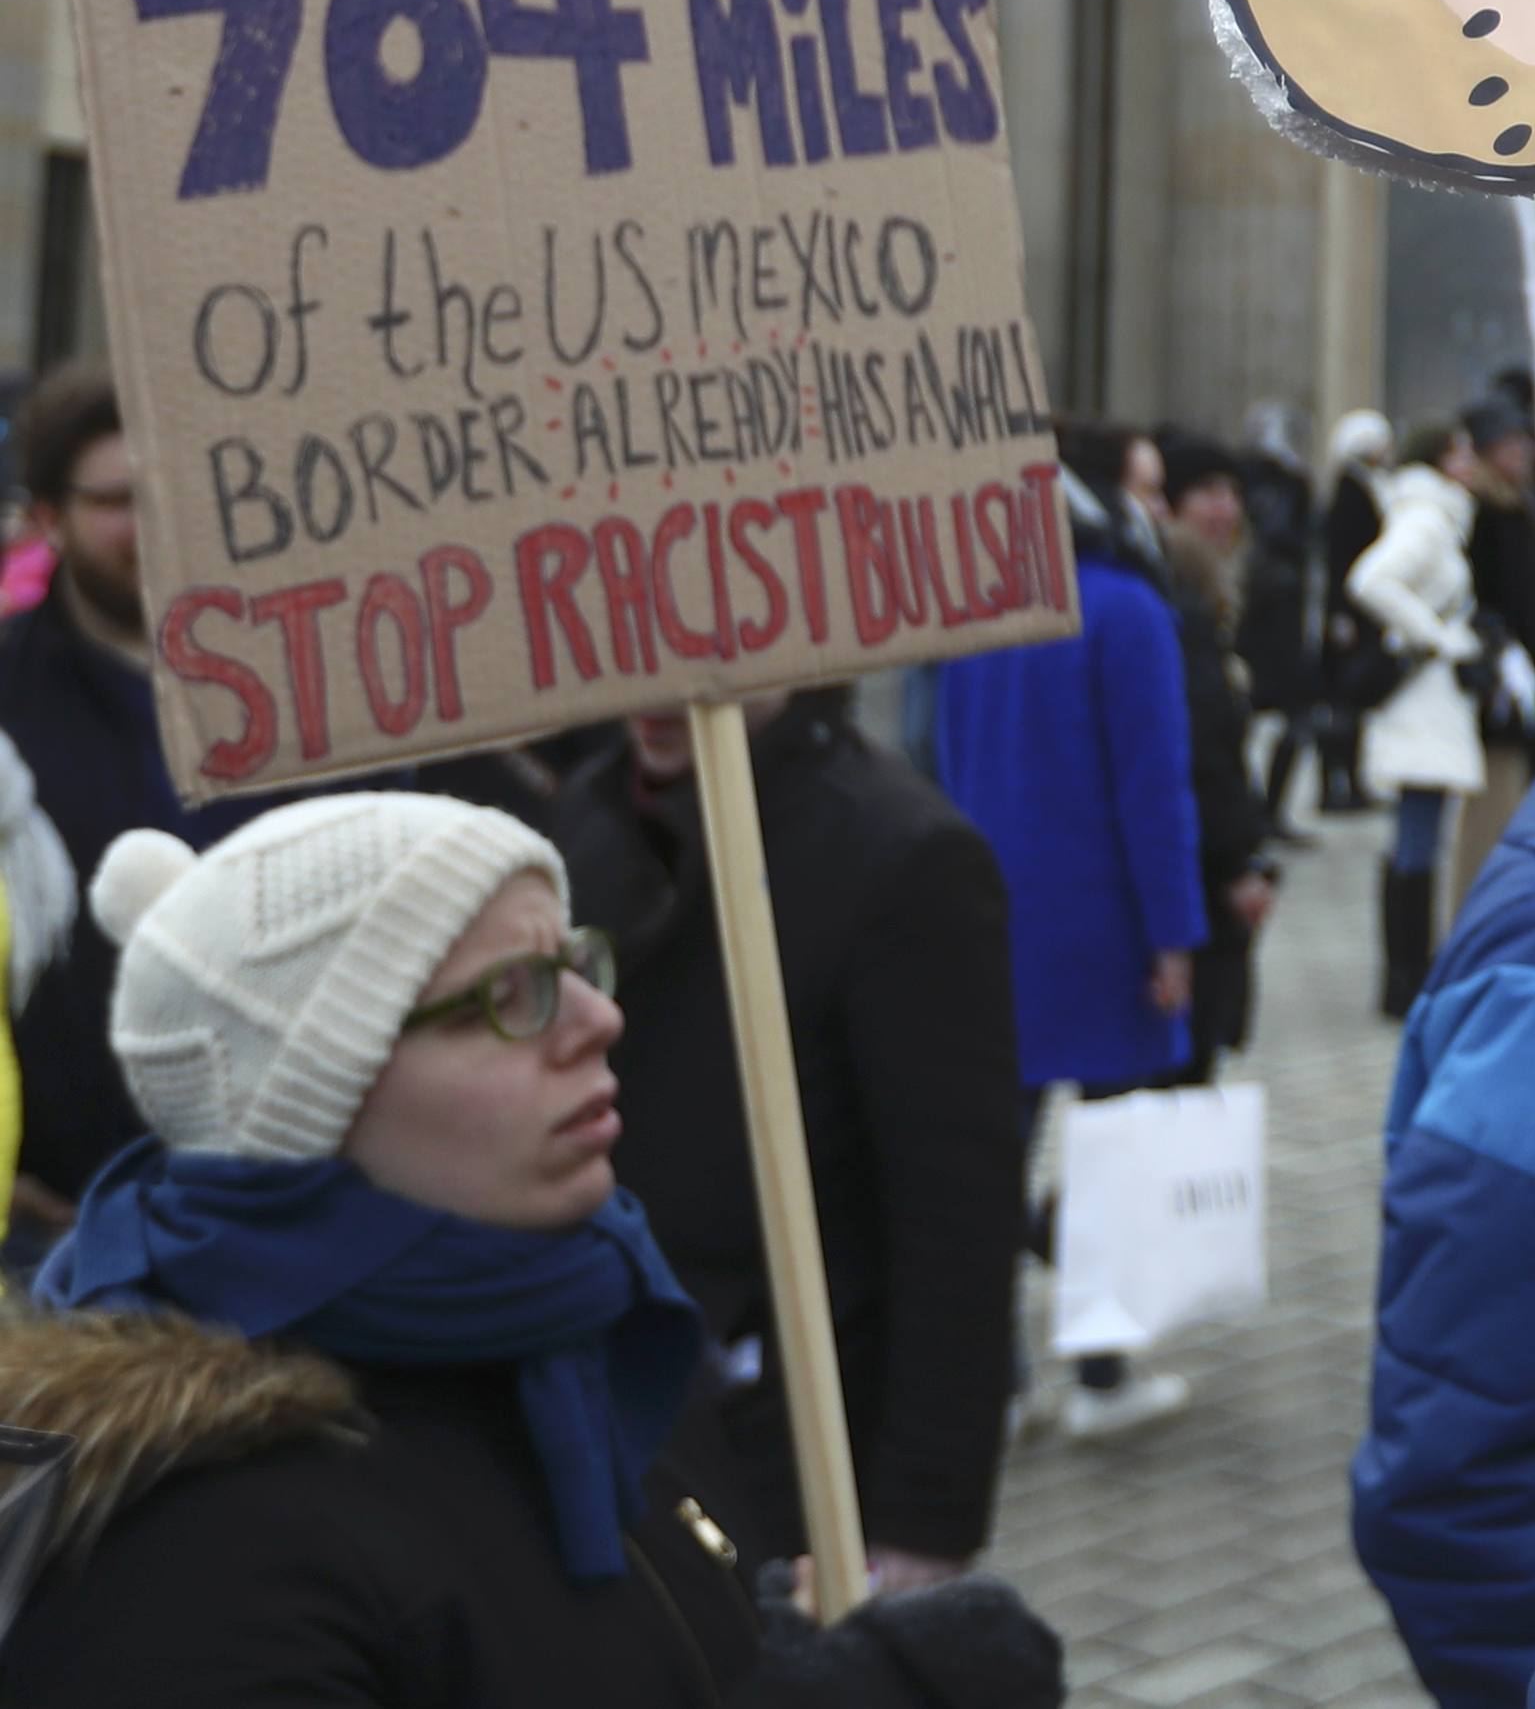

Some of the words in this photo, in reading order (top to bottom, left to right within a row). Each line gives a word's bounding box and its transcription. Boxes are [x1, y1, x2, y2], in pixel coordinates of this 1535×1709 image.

[208, 394, 551, 565] BORDER
[573, 345, 803, 477] ALREADY
[160, 544, 494, 782] STOP
[515, 487, 830, 690] RACIST
